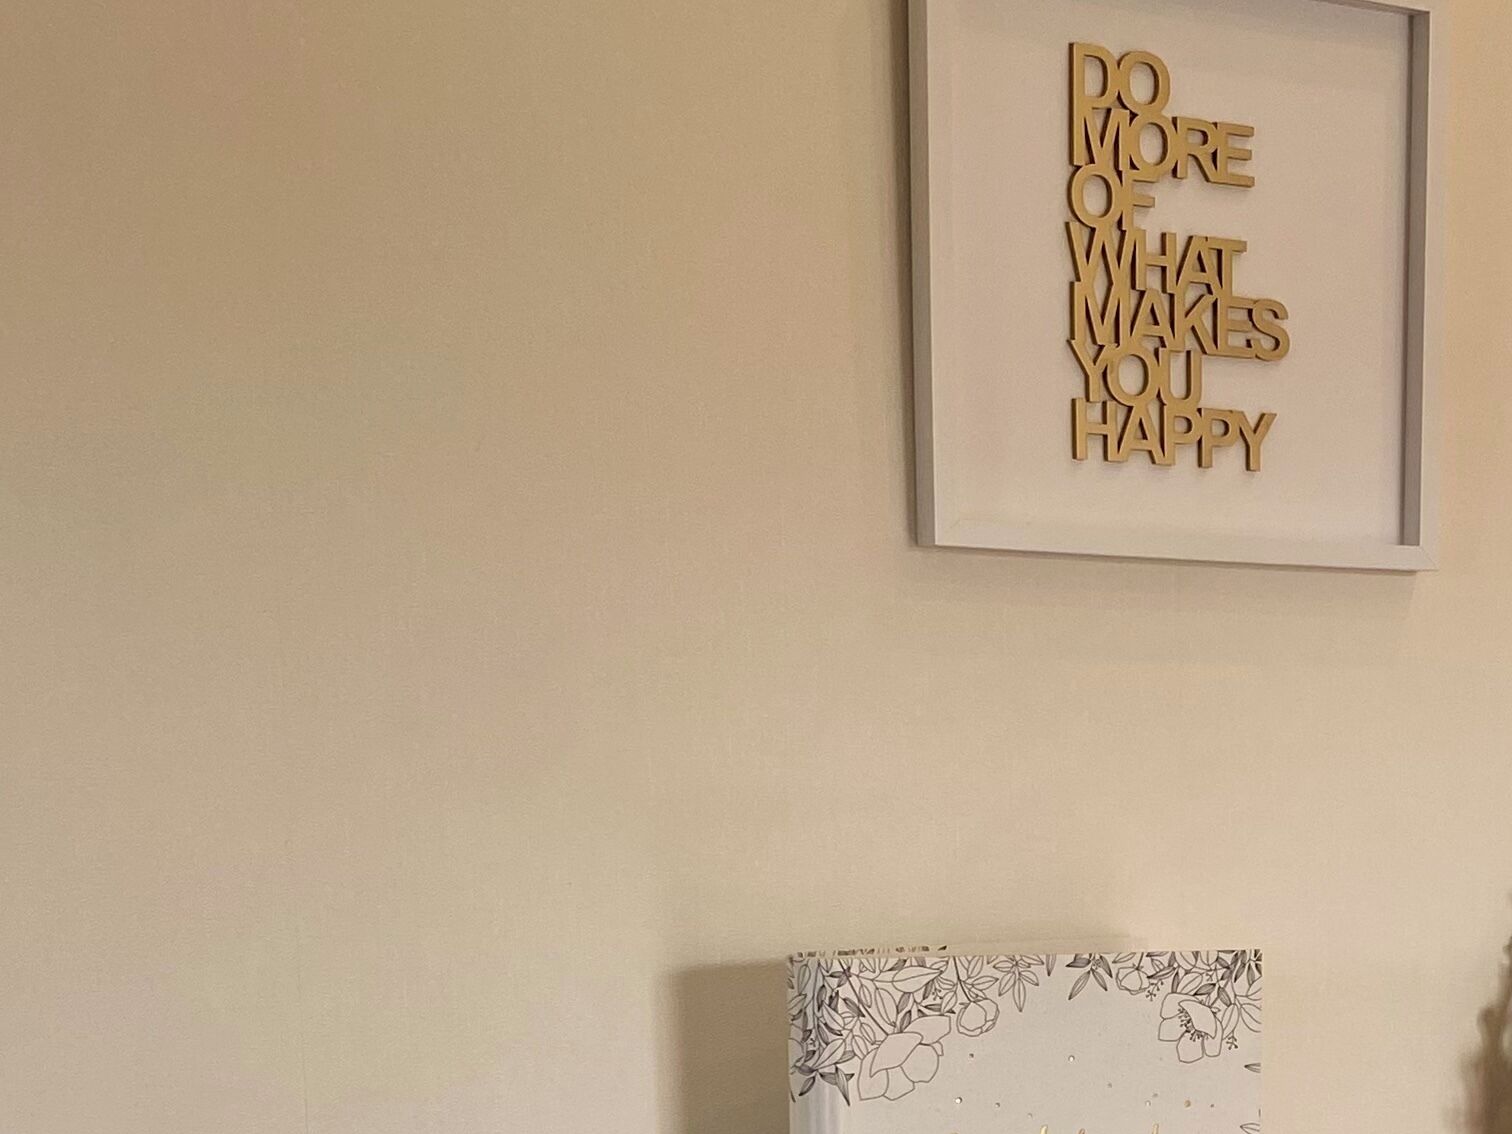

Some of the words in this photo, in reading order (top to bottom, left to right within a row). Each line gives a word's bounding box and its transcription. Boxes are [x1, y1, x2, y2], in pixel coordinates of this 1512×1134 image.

[1068, 42, 1171, 116] DO
[1068, 109, 1256, 188] MORE
[1067, 164, 1156, 231] OF
[1065, 221, 1248, 297] WHAT
[1069, 281, 1291, 361] MAKES
[1067, 339, 1203, 407] YOU
[1071, 398, 1278, 472] HAPPY
